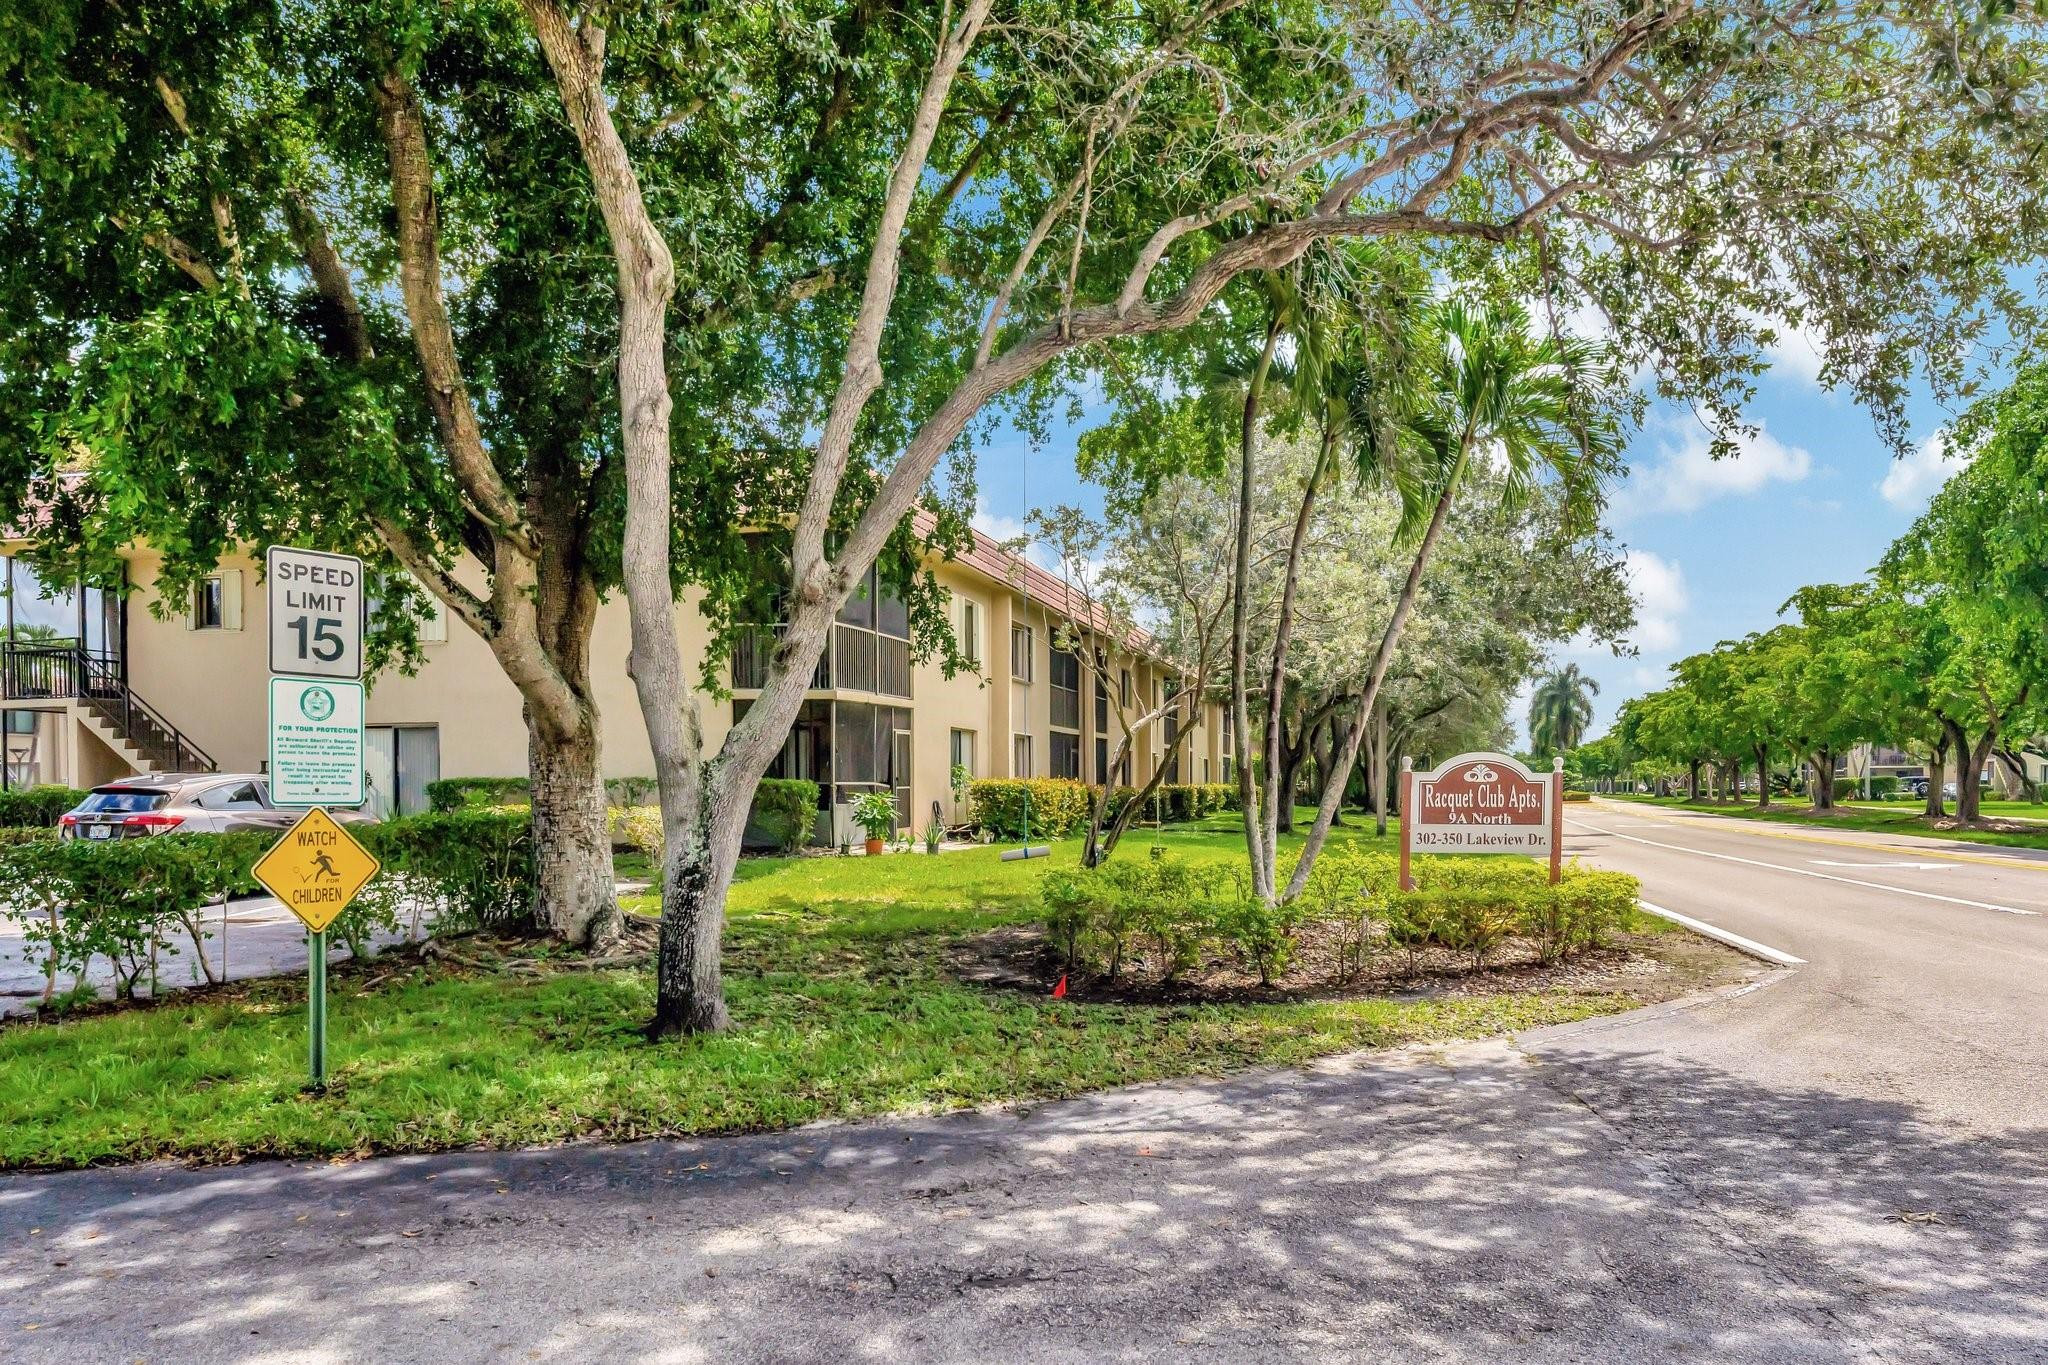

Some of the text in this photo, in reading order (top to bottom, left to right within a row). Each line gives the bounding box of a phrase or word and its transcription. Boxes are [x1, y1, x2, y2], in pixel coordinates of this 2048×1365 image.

[278, 562, 354, 587] SPEED
[286, 590, 346, 612] LIMIT
[288, 616, 344, 662] 15
[1425, 784, 1540, 813] Racquet Club Apts.
[1449, 813, 1512, 824] 9A North
[298, 831, 336, 846] WATCH
[1416, 832, 1546, 846] 302-350 Lakeview Dr.
[292, 886, 342, 904] CHILDREN
